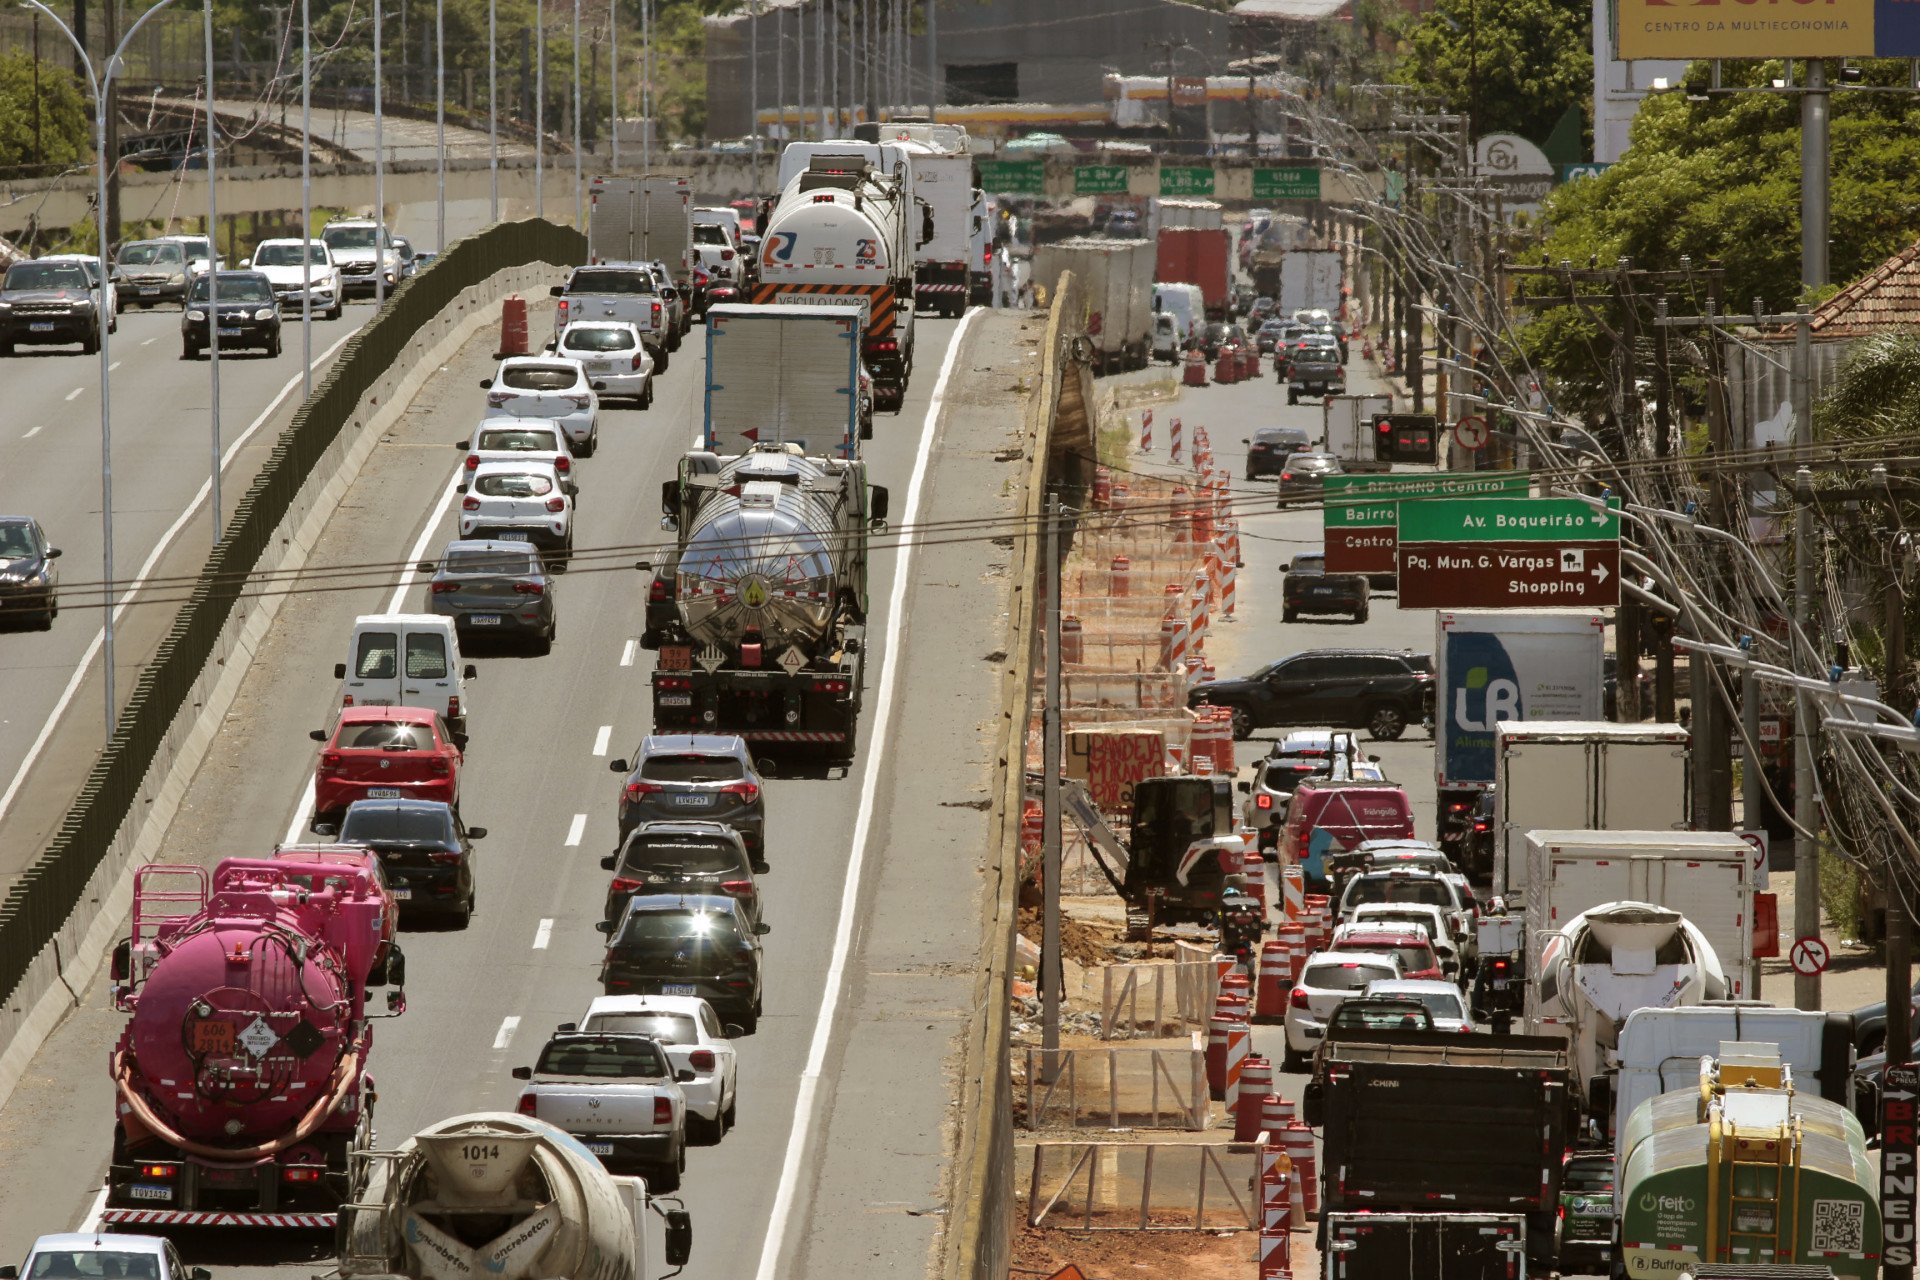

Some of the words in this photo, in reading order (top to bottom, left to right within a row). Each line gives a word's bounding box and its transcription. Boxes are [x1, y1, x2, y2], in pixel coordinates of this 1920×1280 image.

[1645, 21, 1700, 32] CENTRO
[1706, 21, 1725, 31] DA
[1731, 20, 1849, 31] MULTIECONOMIA
[1463, 515, 1487, 527] Av.
[1345, 536, 1393, 548] Centro
[1407, 556, 1431, 571] Pq.
[1437, 557, 1474, 569] Mun.
[1478, 556, 1492, 569] G.
[1498, 556, 1555, 572] Vargas
[1508, 581, 1585, 595] Shopping
[203, 1023, 225, 1036] 606
[461, 1144, 500, 1160] 1014
[1658, 1195, 1696, 1212] feito
[1651, 1258, 1690, 1271] Buffon
